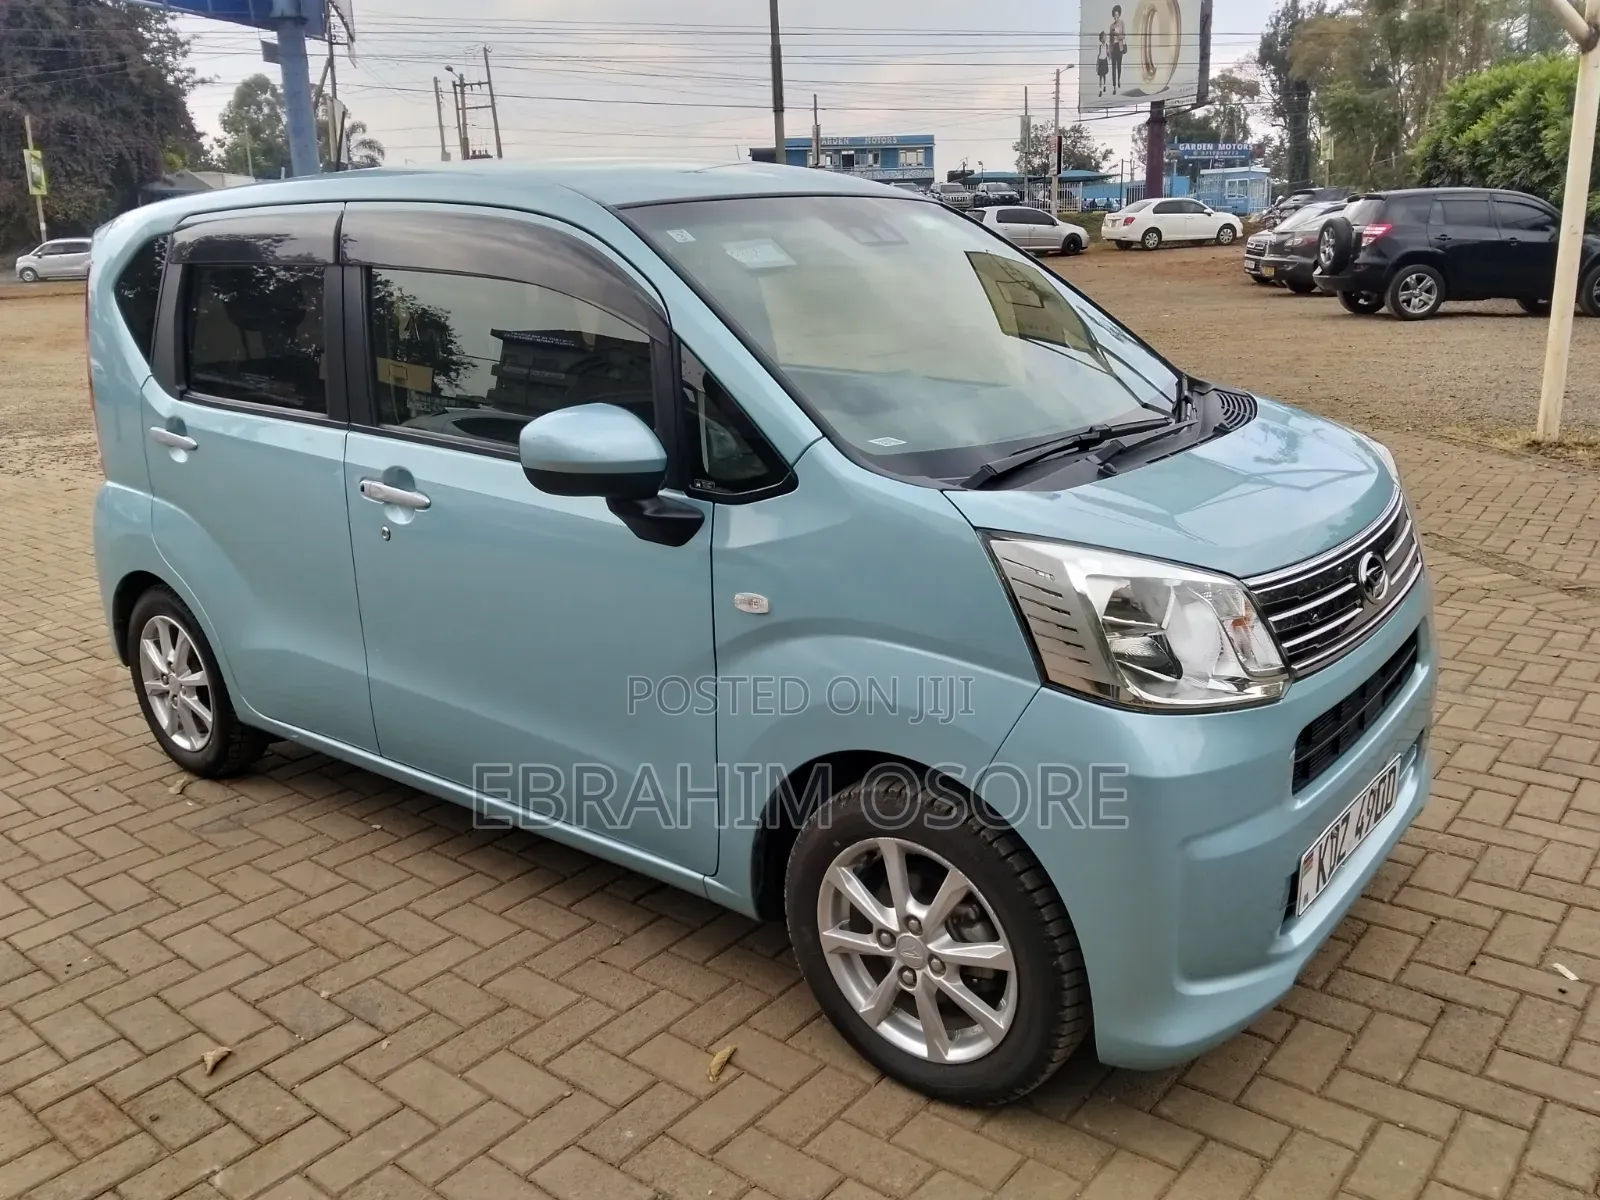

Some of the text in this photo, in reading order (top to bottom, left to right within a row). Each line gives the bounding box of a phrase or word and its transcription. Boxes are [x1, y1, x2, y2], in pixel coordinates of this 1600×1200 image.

[821, 136, 898, 145] ARDEN MOTORS
[1179, 143, 1253, 151] GARDEN MOTORS
[1316, 766, 1396, 893] KDZ 490D
